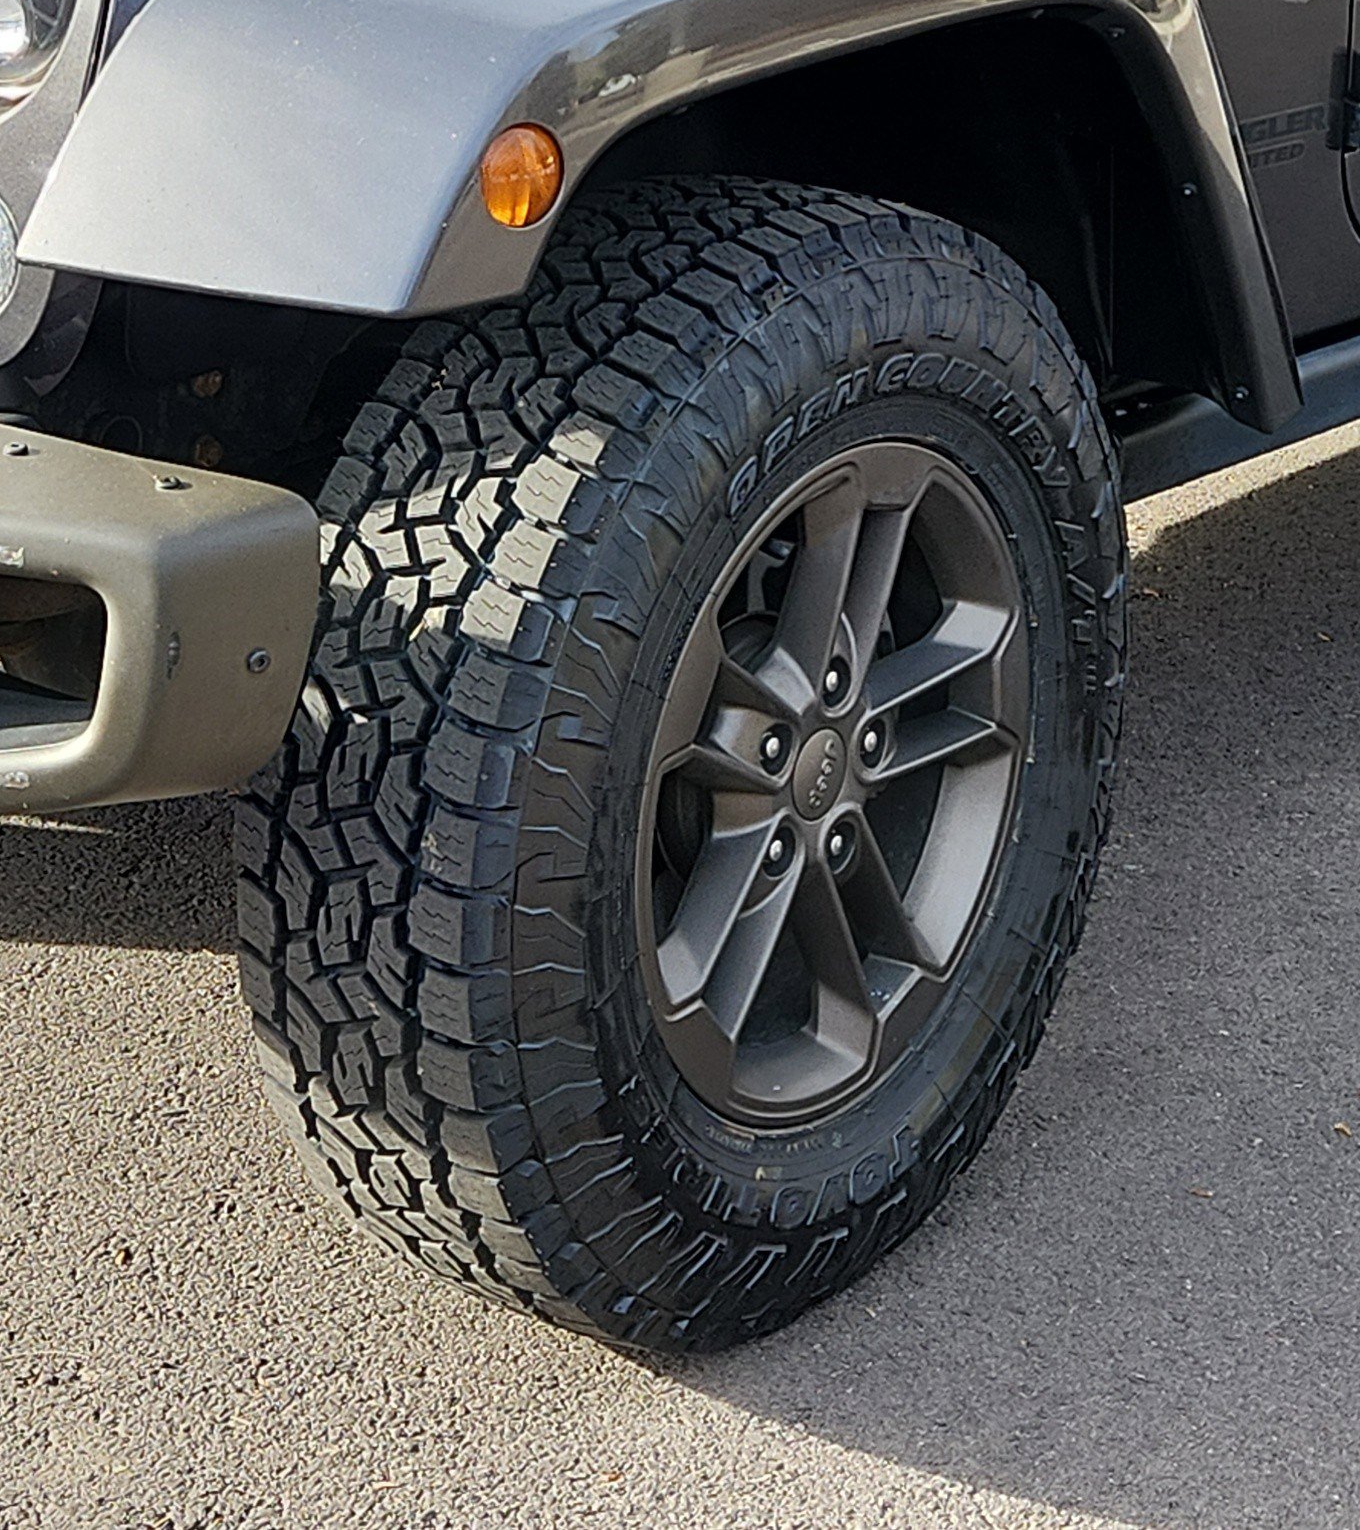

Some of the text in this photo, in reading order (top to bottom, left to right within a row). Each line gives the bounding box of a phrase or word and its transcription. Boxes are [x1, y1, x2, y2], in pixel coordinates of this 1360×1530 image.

[726, 365, 873, 518] OPEN
[873, 351, 1071, 488] COUNTRY
[808, 738, 837, 810] Jeep
